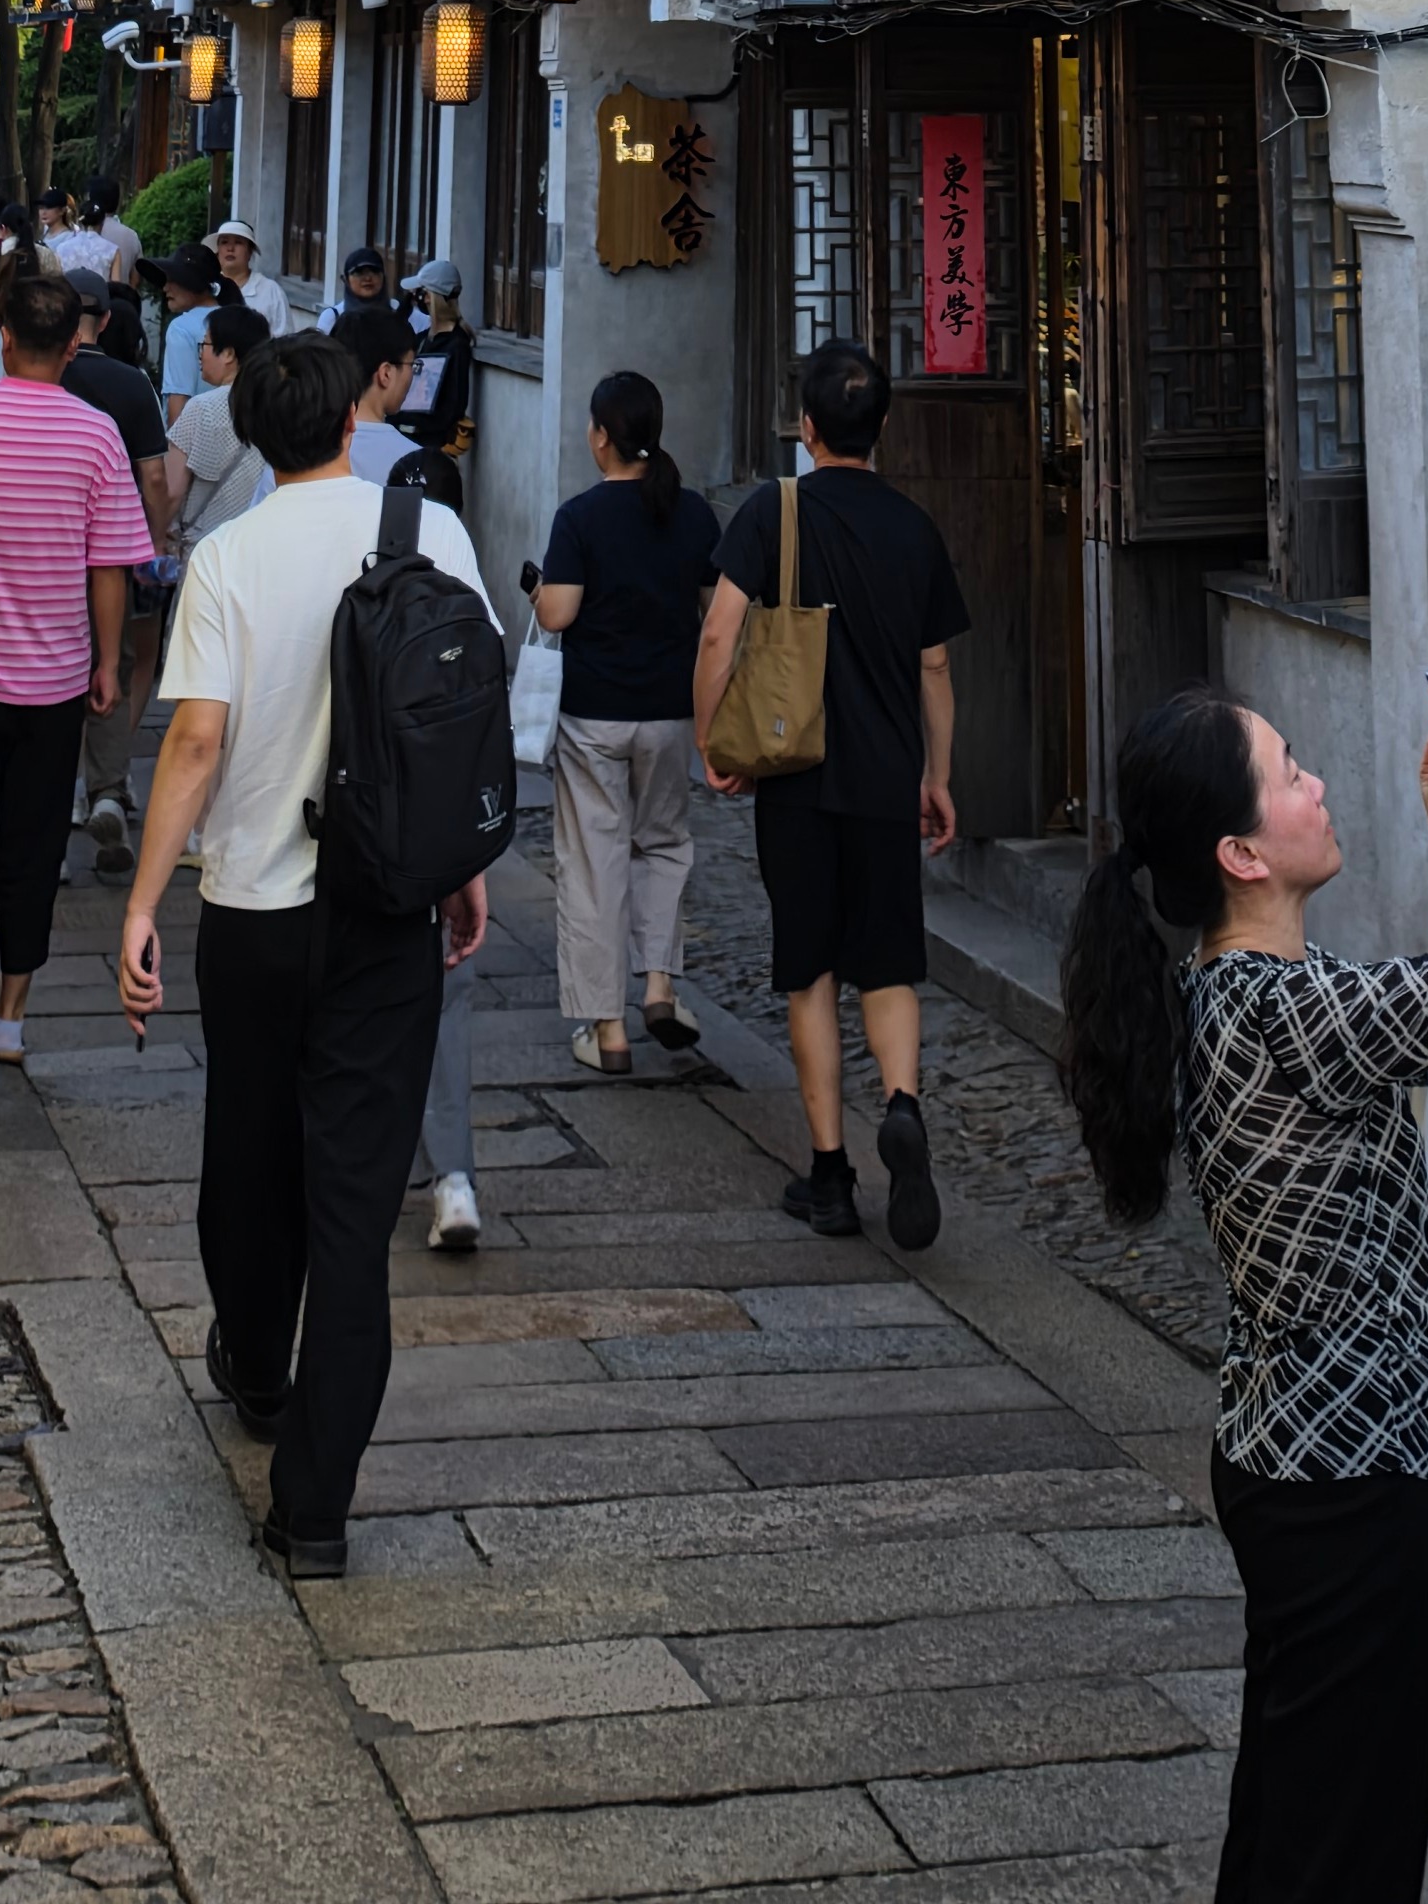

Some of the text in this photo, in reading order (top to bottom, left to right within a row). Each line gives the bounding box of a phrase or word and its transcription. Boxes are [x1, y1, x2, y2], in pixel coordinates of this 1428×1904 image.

[660, 123, 716, 252] 茶舍
[939, 153, 975, 336] 東方美學
